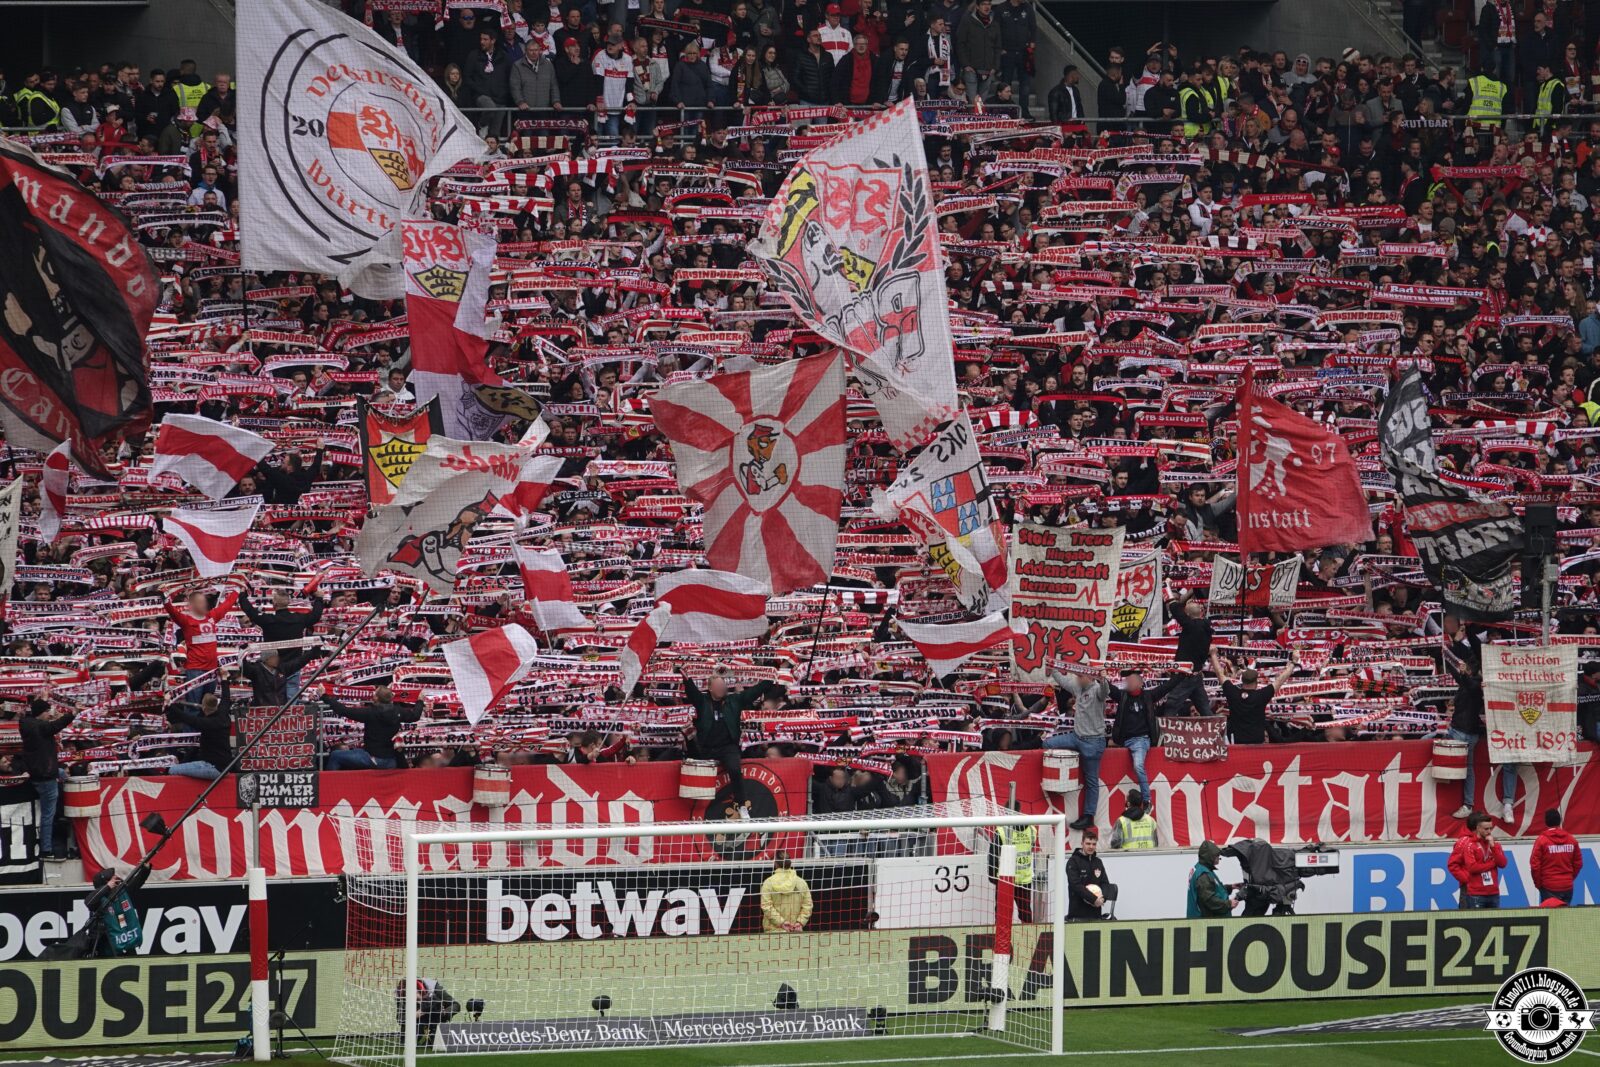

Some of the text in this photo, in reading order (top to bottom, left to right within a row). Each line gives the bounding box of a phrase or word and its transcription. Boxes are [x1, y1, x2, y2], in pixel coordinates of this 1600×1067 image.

[293, 115, 325, 138] 20
[1309, 441, 1337, 465] 97
[1248, 509, 1313, 529] nstatt
[1019, 527, 1114, 546] Stolz Treue
[1046, 548, 1095, 563] Hingabe
[1015, 559, 1110, 580] Leidenschaft
[1012, 602, 1107, 627] Bestimmung
[1501, 652, 1560, 666] Tradition
[1497, 670, 1566, 684] verpflichtet
[882, 706, 957, 719] COMMANDO
[1158, 717, 1202, 733] ULTRA
[1164, 733, 1187, 745] DER
[1491, 731, 1578, 751] Seit 1893
[1164, 746, 1190, 758] UMS
[240, 757, 314, 771] ZURÜCK
[259, 773, 314, 784] DU BIST
[259, 784, 314, 797] IMMER
[259, 796, 316, 807] BEI UNS!
[934, 864, 970, 893] 35
[486, 880, 747, 943] betway
[664, 1013, 863, 1039] Mercedes-Benz Bank
[450, 1022, 648, 1048] Mercedes-Benz Bank
